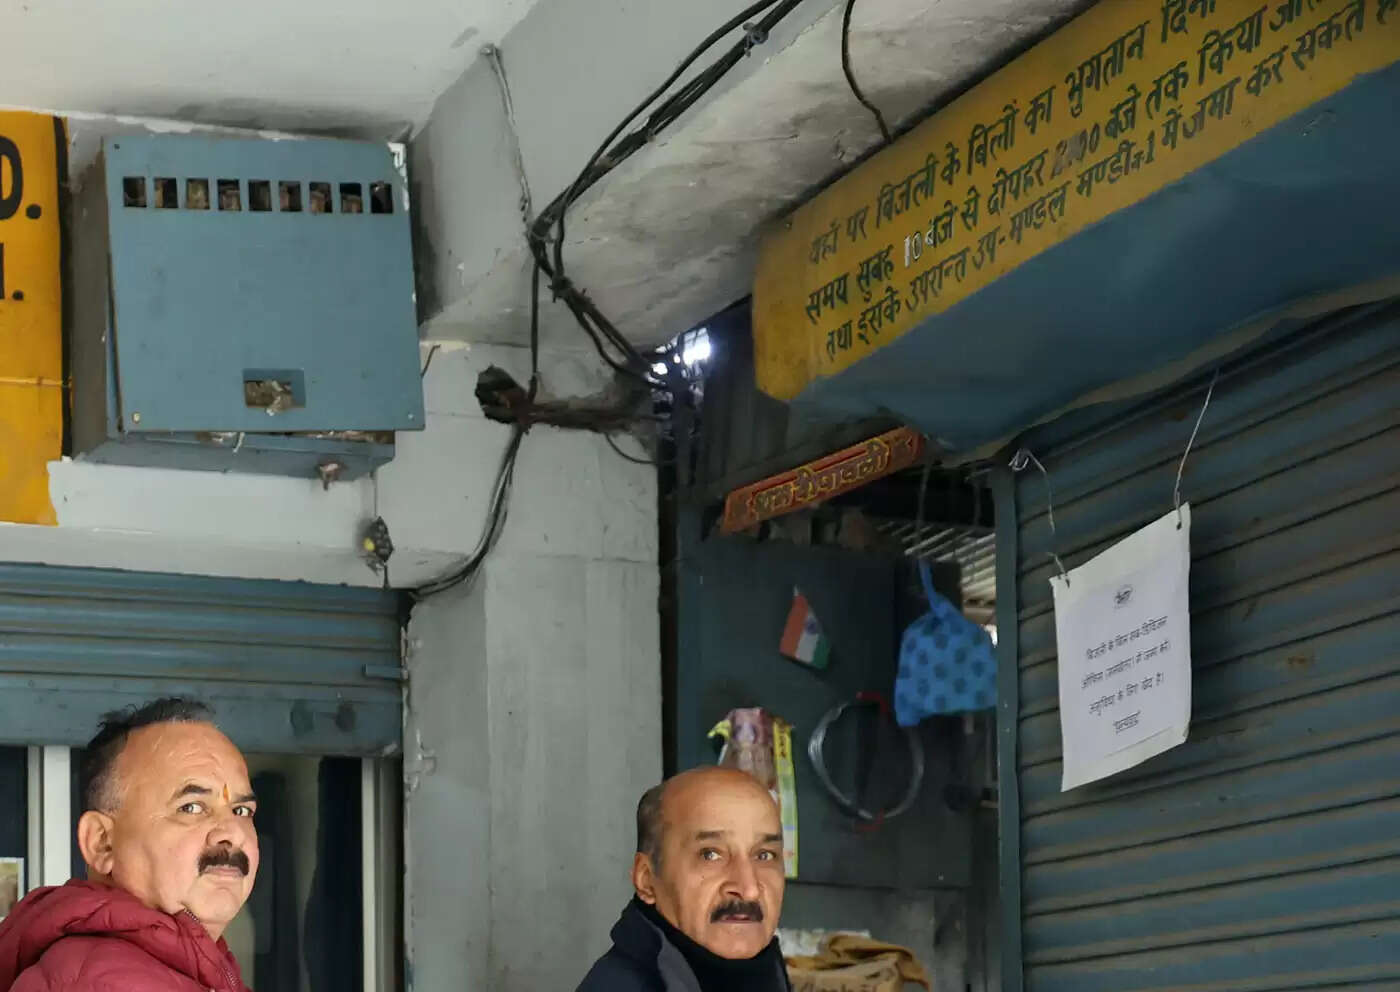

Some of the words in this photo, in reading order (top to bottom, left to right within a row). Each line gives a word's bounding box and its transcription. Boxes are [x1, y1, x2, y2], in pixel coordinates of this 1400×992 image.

[805, 272, 850, 325] समय
[960, 185, 981, 231] से
[1105, 83, 1141, 139] बजे
[1145, 61, 1189, 120] तक
[1196, 5, 1268, 85] किया
[826, 320, 853, 362] तथा
[1182, 76, 1241, 139] जमा
[1246, 45, 1289, 97] कर
[846, 205, 869, 242] पर
[876, 152, 939, 230] बिजली
[941, 141, 961, 185] के
[1024, 86, 1056, 135] का
[1065, 20, 1150, 118] भुगतान
